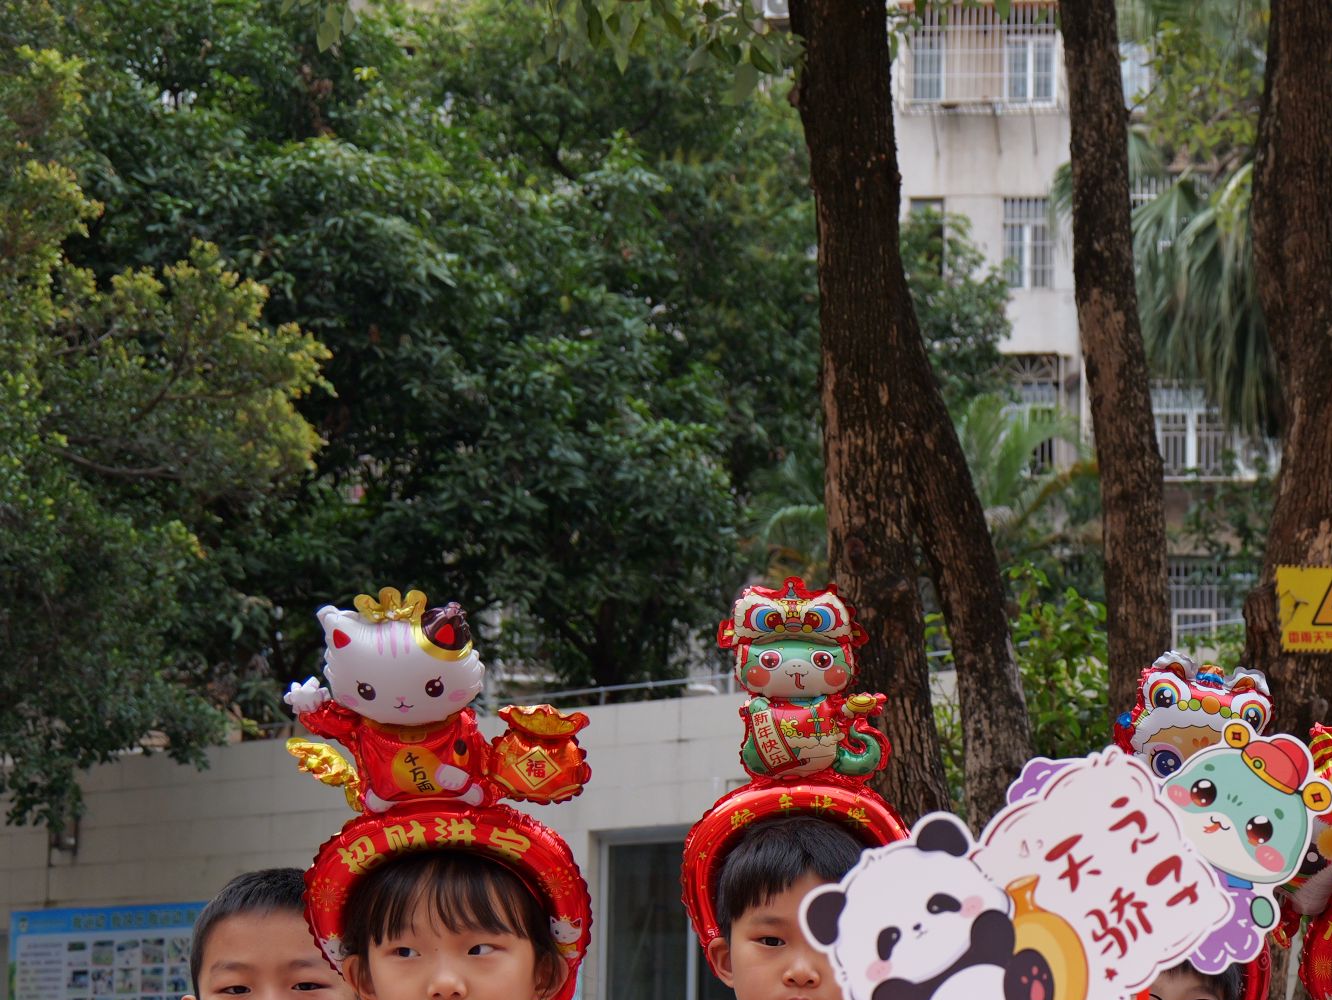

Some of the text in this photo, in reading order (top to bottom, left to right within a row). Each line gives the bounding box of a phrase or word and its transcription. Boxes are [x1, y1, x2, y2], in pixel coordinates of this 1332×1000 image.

[753, 711, 788, 766] 新年快乐
[525, 758, 547, 779] 福
[337, 817, 532, 876] 招财进宝
